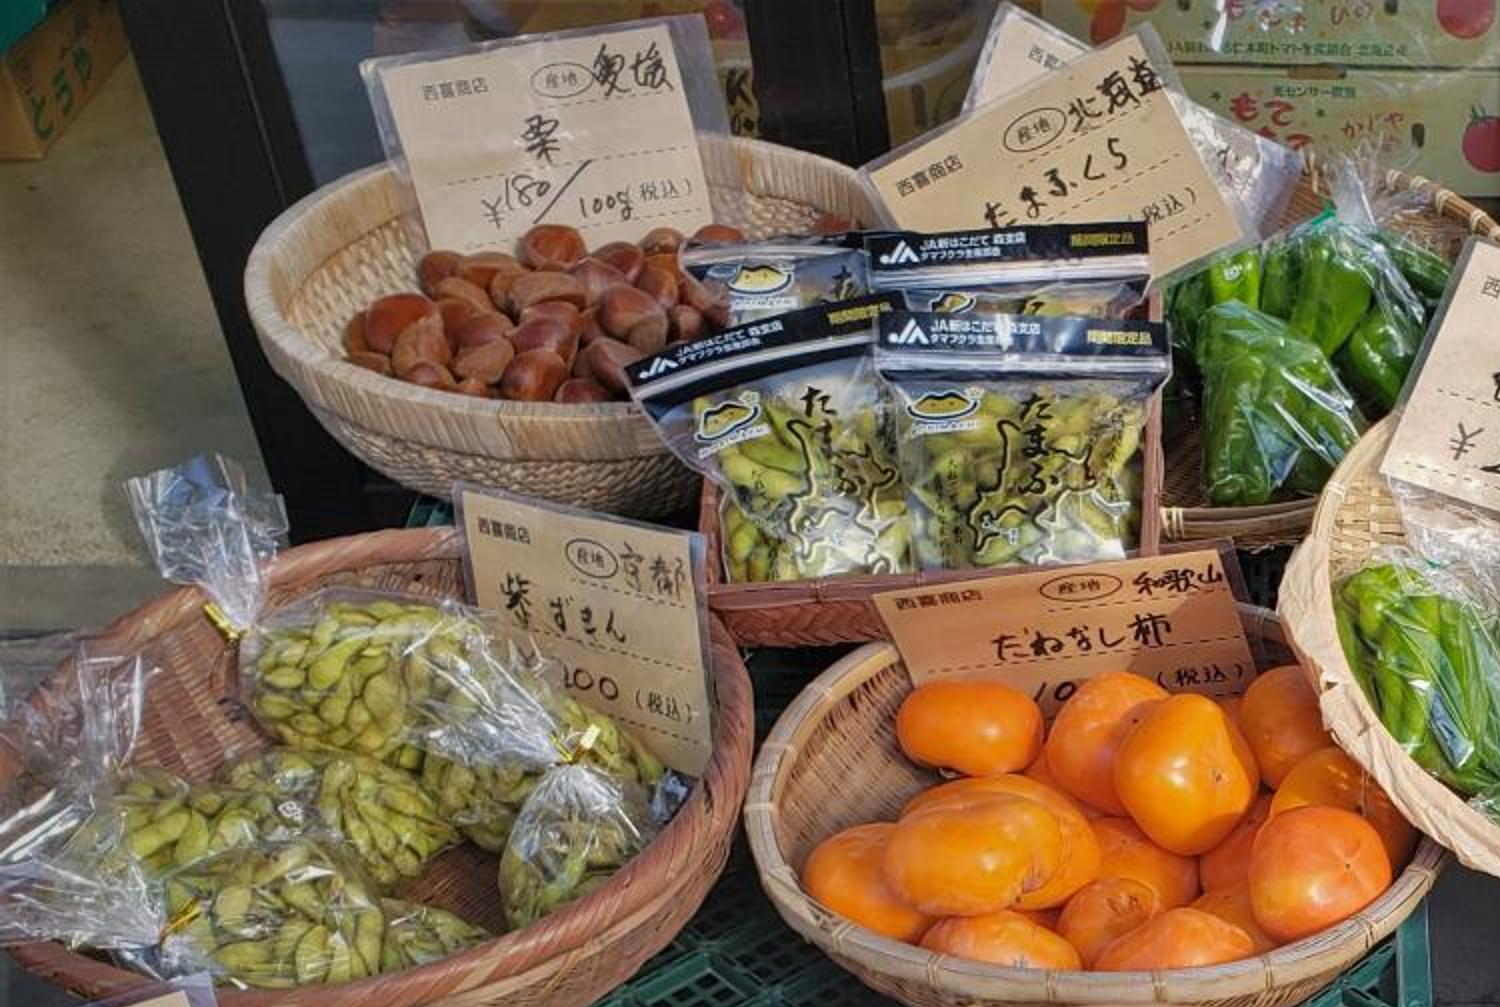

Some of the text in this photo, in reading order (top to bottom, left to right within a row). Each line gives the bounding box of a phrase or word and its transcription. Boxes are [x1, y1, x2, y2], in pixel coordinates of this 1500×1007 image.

[545, 72, 578, 89] 産地
[521, 114, 561, 164] 栗
[896, 154, 964, 197] 西喜商店
[1016, 116, 1052, 145] 産地
[930, 320, 1001, 334] JA新はこだ
[576, 546, 606, 570] 産地
[619, 540, 686, 601] 京都
[895, 563, 1223, 611] 西喜商店 産地 和歌山
[500, 572, 627, 643] 紫ずきん
